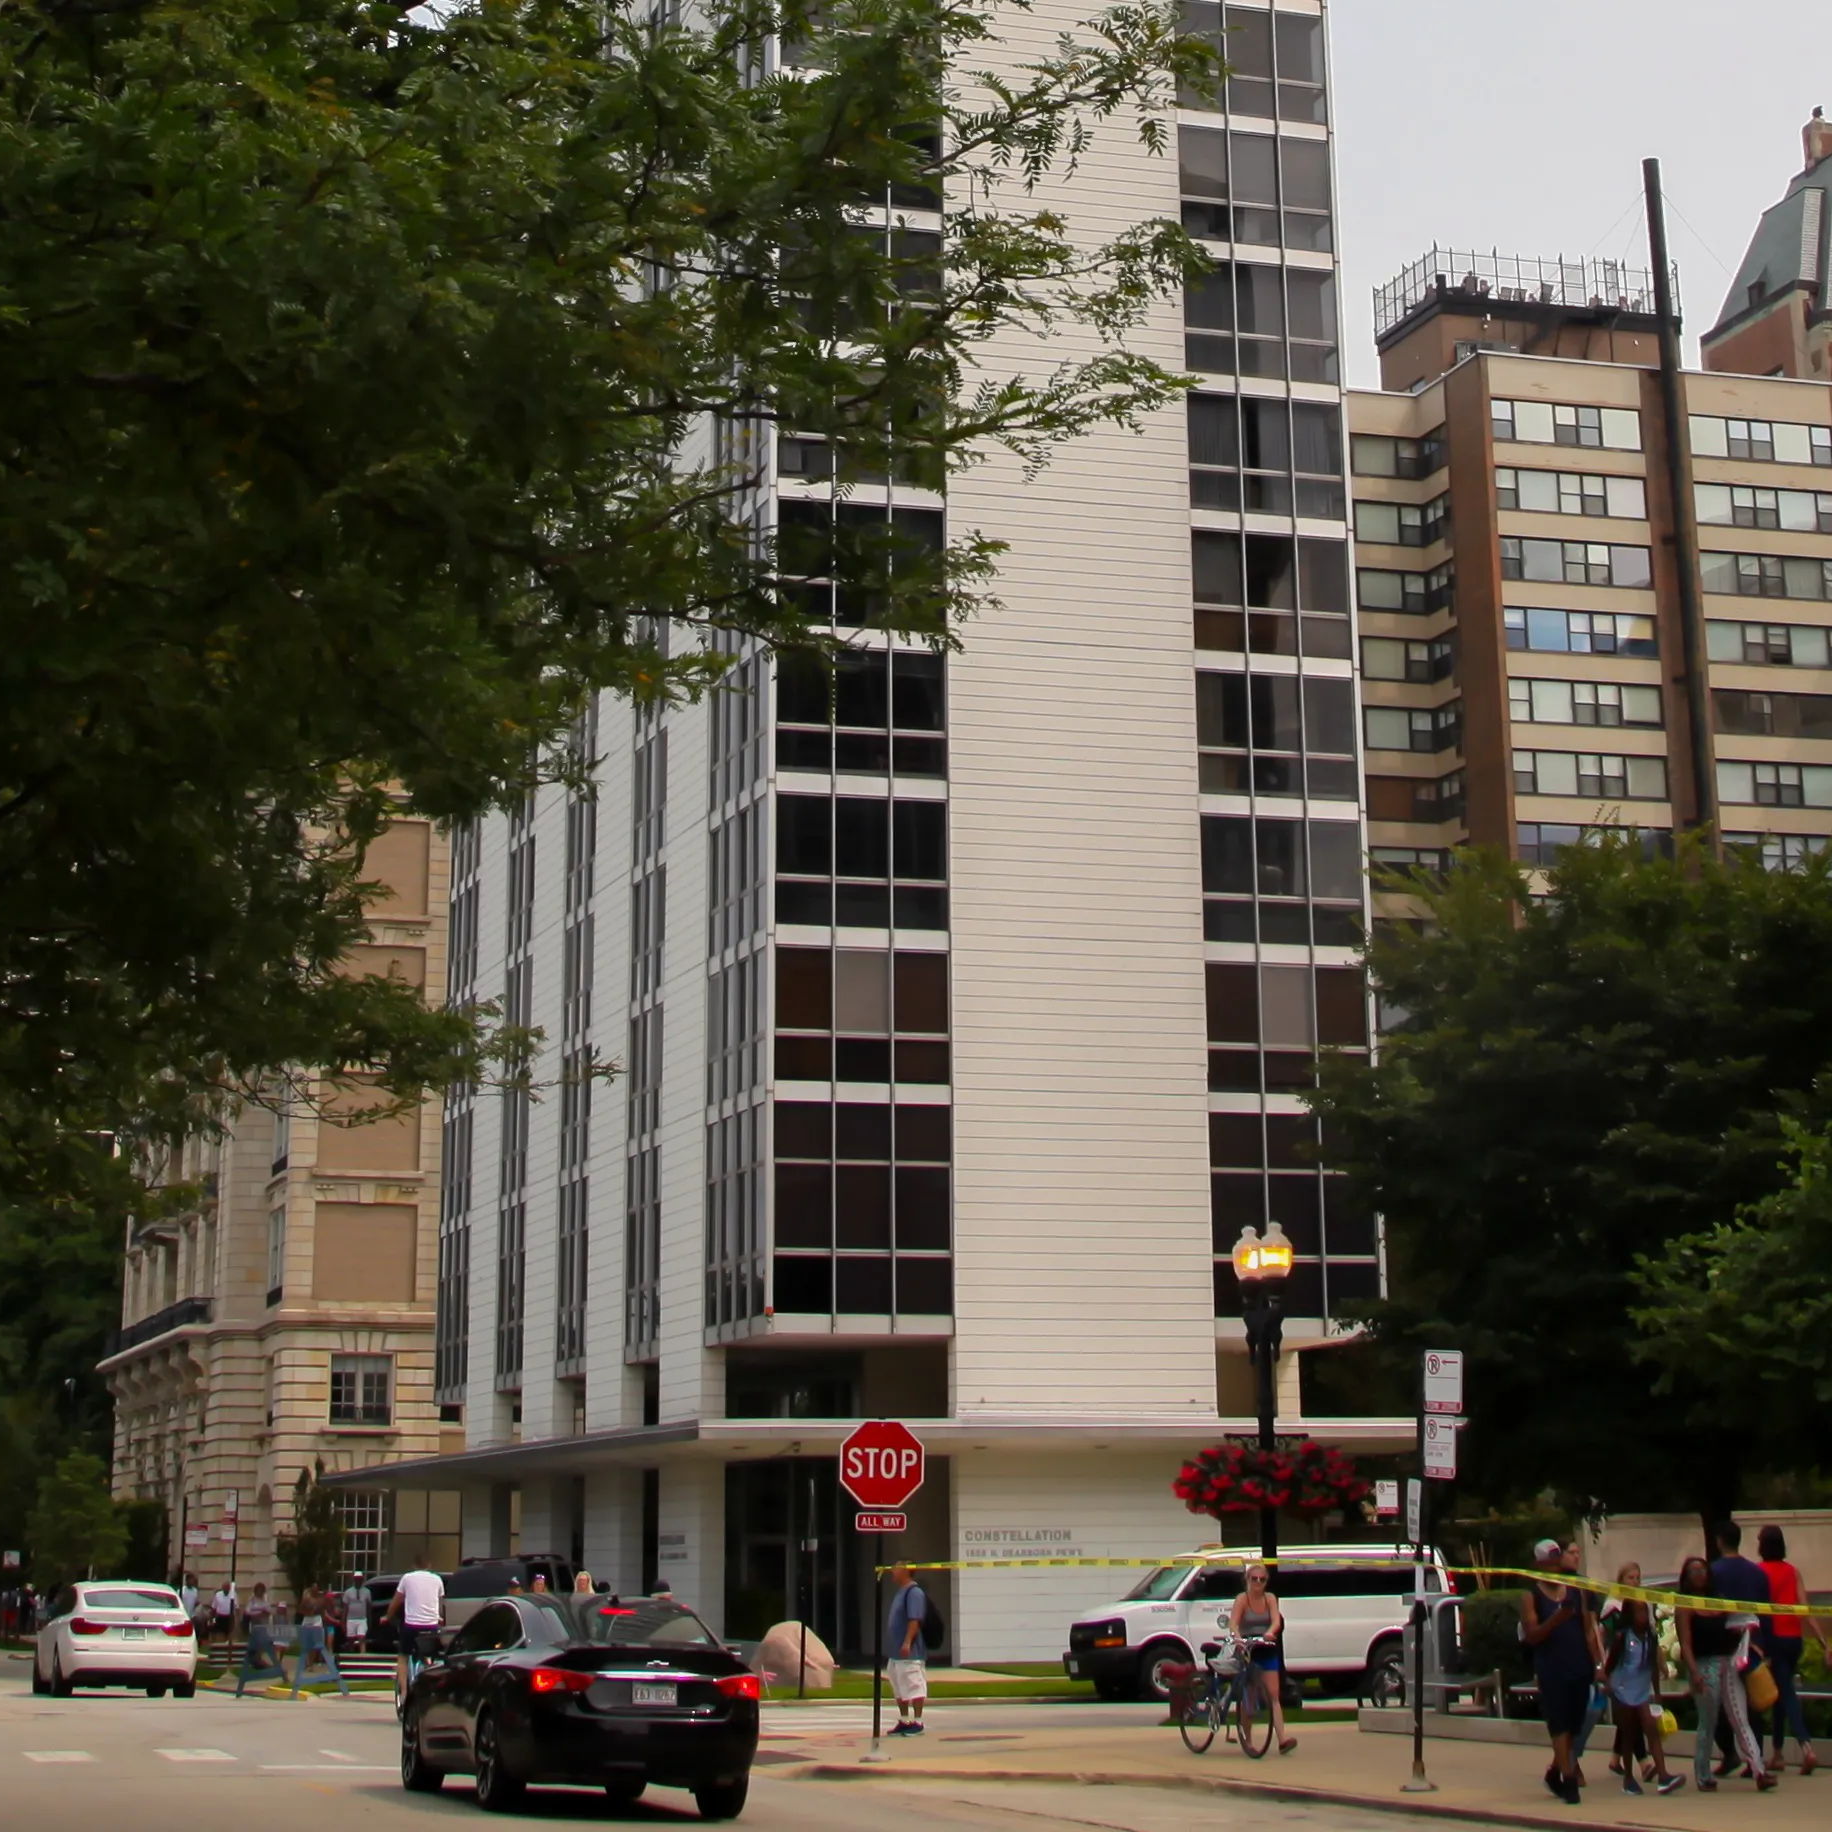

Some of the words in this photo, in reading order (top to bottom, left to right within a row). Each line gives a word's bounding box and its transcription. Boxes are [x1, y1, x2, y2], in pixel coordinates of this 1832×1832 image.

[846, 1447, 919, 1479] STOP
[860, 1516, 879, 1528] ALL
[882, 1516, 902, 1528] WAY
[964, 1529, 1072, 1542] CONSTELLATION
